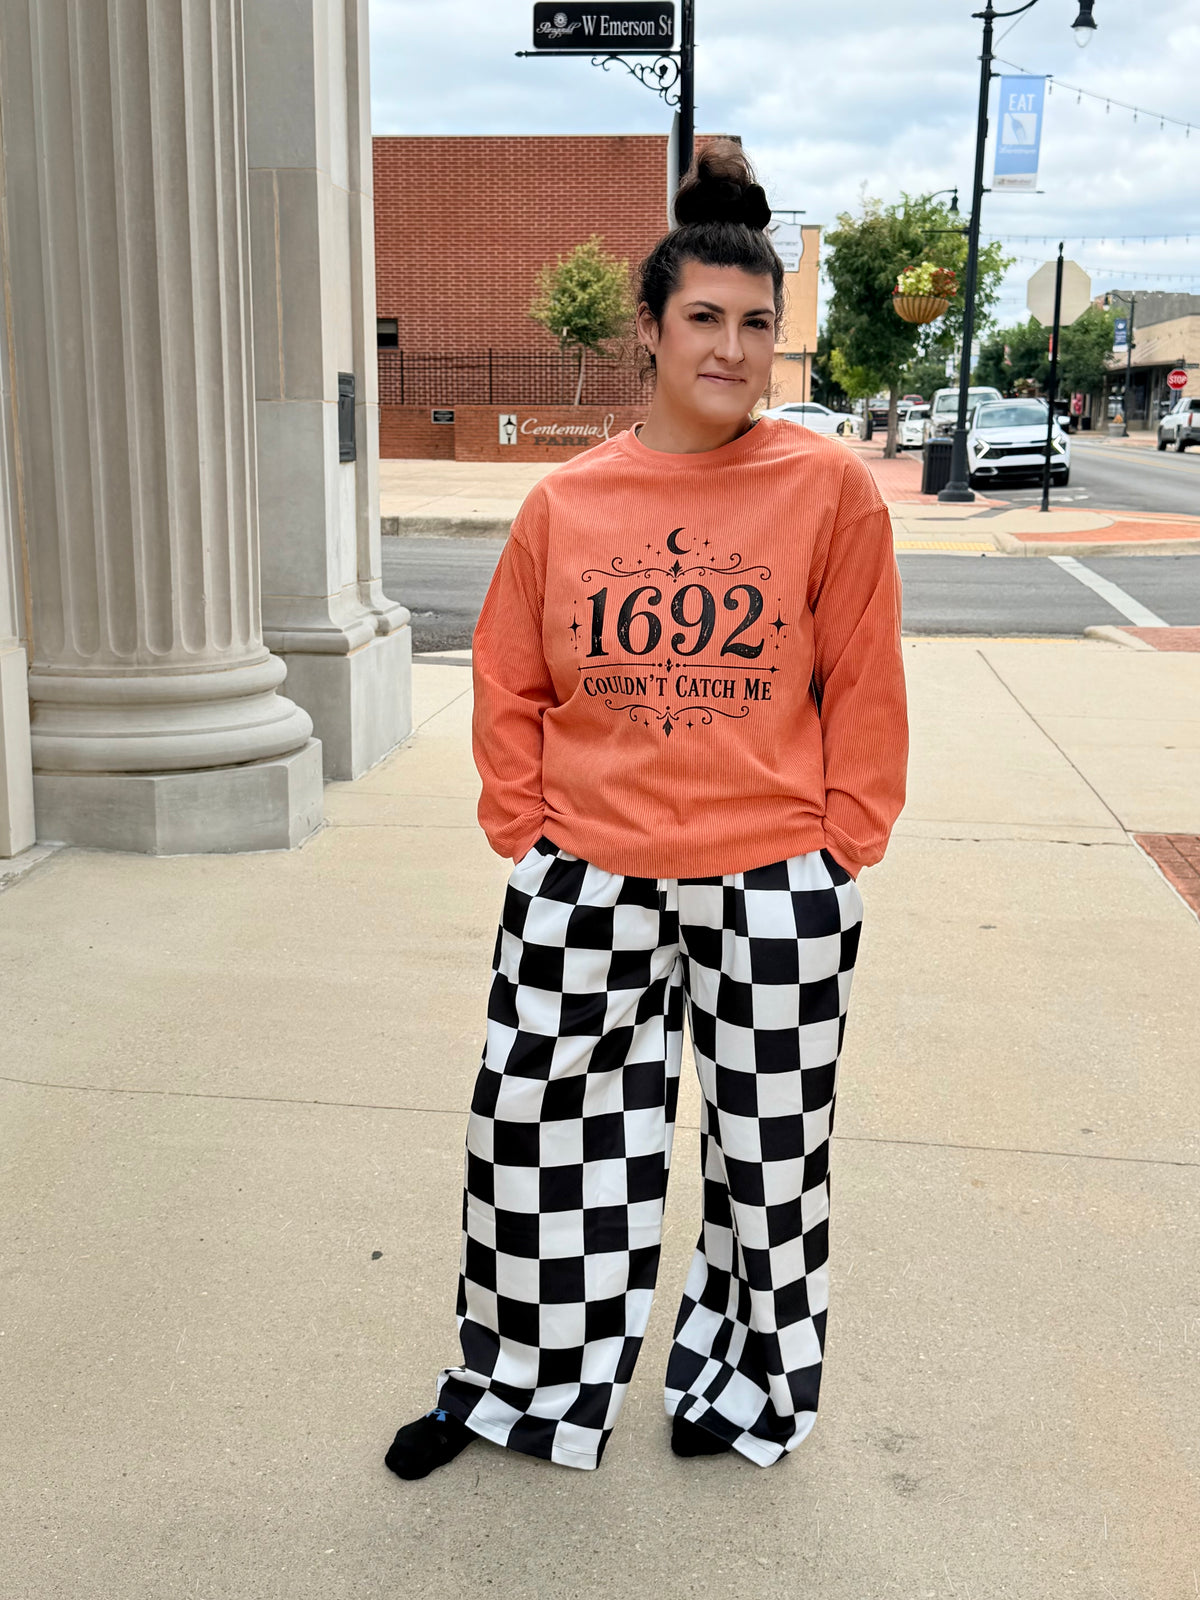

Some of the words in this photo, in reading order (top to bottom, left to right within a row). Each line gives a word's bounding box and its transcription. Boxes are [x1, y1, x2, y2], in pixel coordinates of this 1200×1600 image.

[581, 15, 597, 36] W
[600, 15, 656, 36] Emerson
[658, 14, 673, 36] St
[1008, 93, 1036, 112] EAT
[1168, 374, 1188, 385] STOP
[534, 436, 591, 446] PARK
[586, 583, 765, 660] 1692
[675, 675, 736, 699] CATCH
[743, 677, 772, 701] ME
